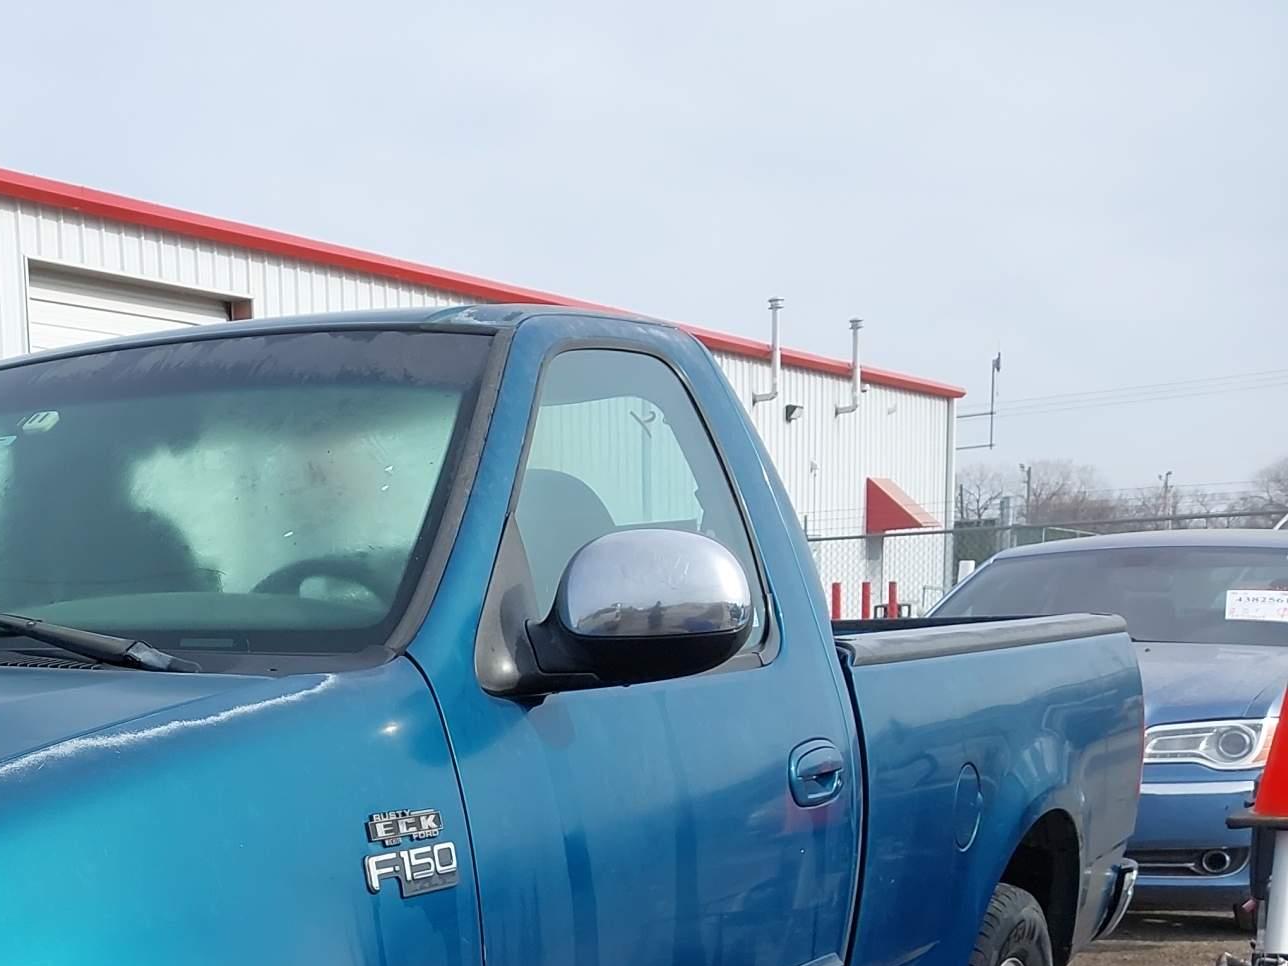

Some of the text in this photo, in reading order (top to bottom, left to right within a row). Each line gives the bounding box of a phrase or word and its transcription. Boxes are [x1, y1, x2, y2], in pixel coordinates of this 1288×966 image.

[372, 810, 412, 822] RUSTY
[375, 815, 438, 838] ECK
[412, 829, 440, 841] FORD
